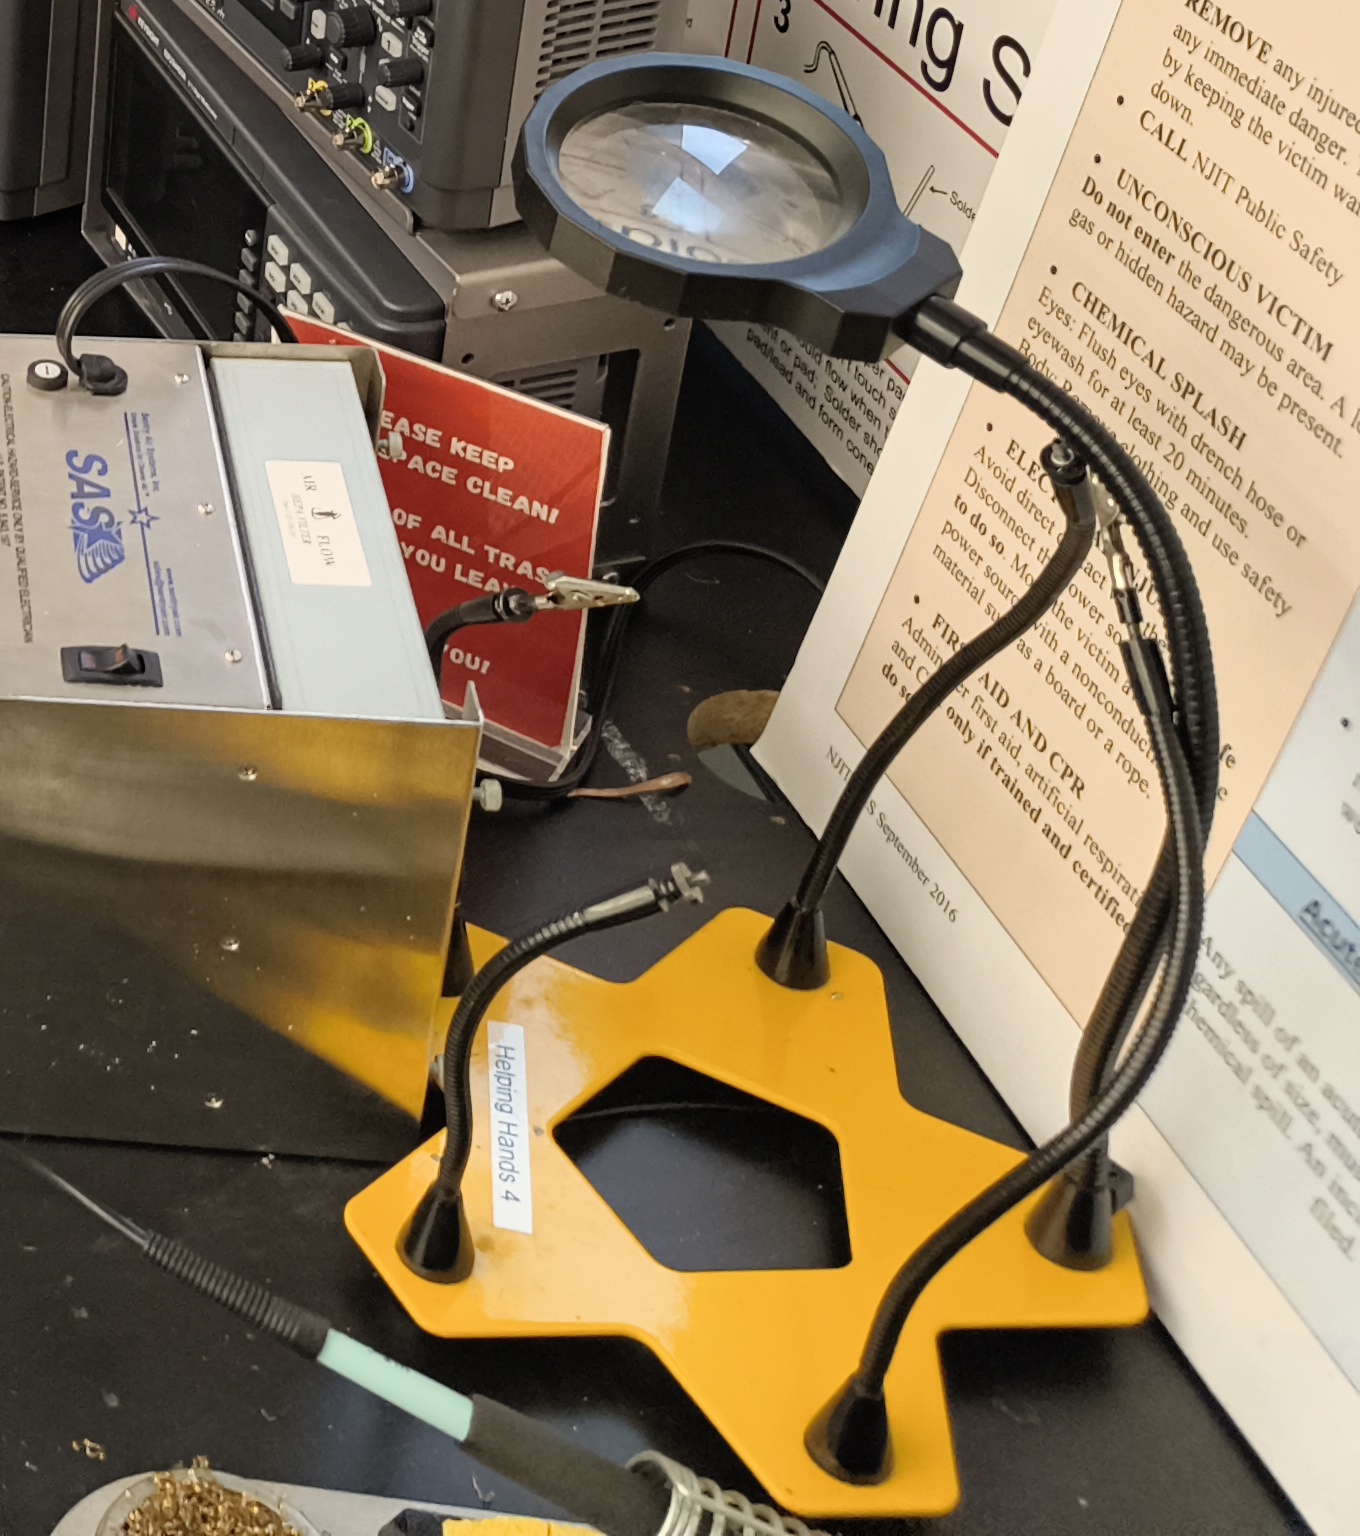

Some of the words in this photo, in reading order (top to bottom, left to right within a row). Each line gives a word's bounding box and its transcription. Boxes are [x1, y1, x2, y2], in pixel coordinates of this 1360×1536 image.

[1139, 109, 1189, 162] CALL
[1191, 149, 1236, 195] NJIT
[1234, 184, 1287, 240] Public
[1288, 229, 1345, 288] Safety
[1081, 175, 1103, 205] Do
[1105, 200, 1134, 231] not
[1133, 225, 1176, 266] enter
[1177, 259, 1202, 290] the
[1203, 284, 1285, 363] dangerous
[1286, 355, 1325, 401] area.
[1116, 168, 1253, 293] UNCONSCIOUS
[1256, 283, 1334, 363] VICTIM
[746, 328, 793, 385] pad/lead
[795, 381, 816, 410] and
[818, 404, 844, 441] form
[1071, 281, 1169, 382] CHEMICAL
[1170, 372, 1248, 452] SPLASH
[380, 410, 443, 448] EASE
[449, 436, 515, 474] KEEP
[823, 385, 862, 434] Solder
[65, 448, 116, 533] SAS
[466, 475, 559, 525] CLEAN!
[317, 534, 335, 567] FLOW
[392, 508, 422, 530] OF
[431, 525, 476, 555] ALL
[484, 544, 555, 587] TRAS
[399, 541, 446, 574] YOU
[977, 670, 1011, 710] AID
[1009, 709, 1048, 754] AND
[1048, 749, 1086, 801] CPR
[876, 811, 930, 886] September
[929, 881, 959, 924] 2016
[494, 1044, 518, 1115] Helping
[498, 1120, 520, 1183] Hands
[501, 1190, 520, 1202] 4
